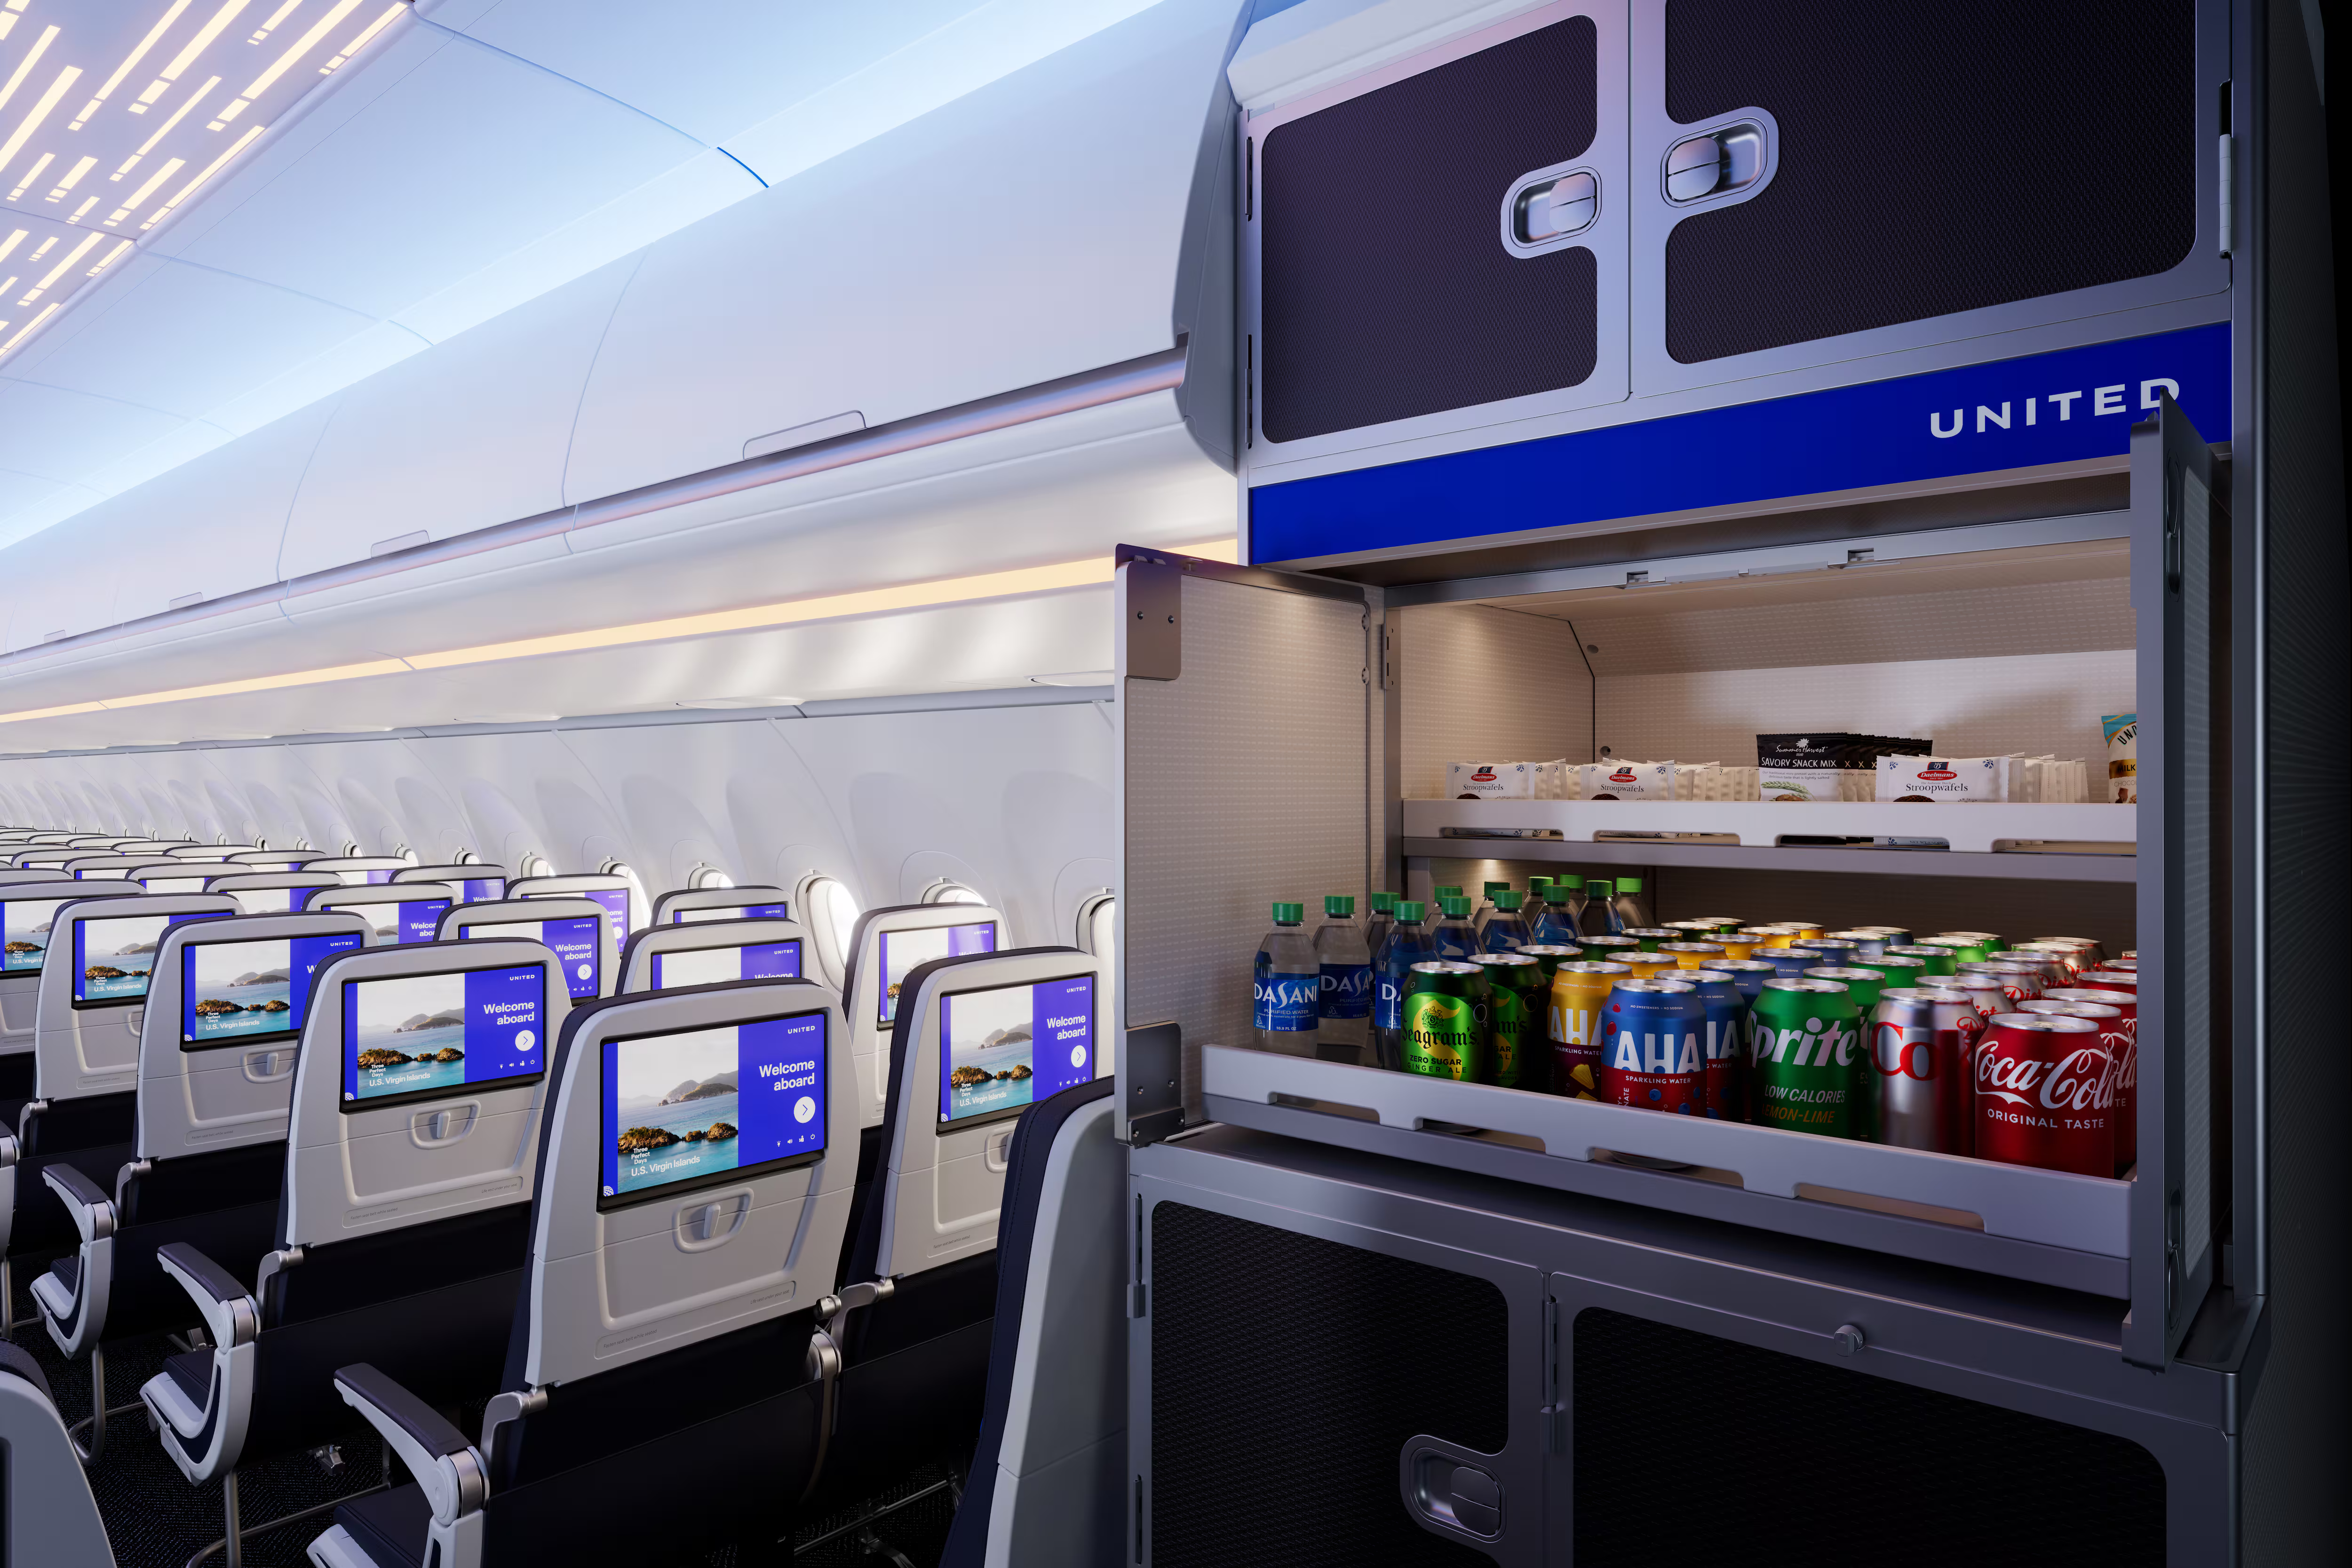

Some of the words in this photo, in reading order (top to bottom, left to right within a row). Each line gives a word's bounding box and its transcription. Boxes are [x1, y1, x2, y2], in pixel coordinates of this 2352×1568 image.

[1931, 378, 2179, 438] UNITED
[1762, 757, 1790, 766] SAVORY
[1463, 784, 1503, 792] Stroopwafels
[1601, 784, 1644, 793] Stroopwafels
[1906, 783, 1968, 794] Stroopwafels
[565, 951, 591, 960] aboard
[1320, 971, 1370, 997] DASA
[1254, 982, 1317, 1008] DASANI
[484, 1002, 534, 1014] Welcome
[497, 1011, 534, 1025] aboard
[1047, 1015, 1086, 1028] Welcome
[788, 1026, 815, 1034] UNITED
[1057, 1025, 1086, 1040] aboard
[1751, 1010, 1857, 1068] Sprite
[1555, 1046, 1581, 1055] SPARKLING
[1614, 1031, 1701, 1074] AHA
[1410, 1055, 1429, 1064] ZERO
[759, 1060, 815, 1077] Welcome
[1407, 1062, 1441, 1073] GINGER
[407, 1073, 430, 1081] Islands
[774, 1073, 815, 1091] aboard
[1625, 1075, 1667, 1084] SPARKLING
[1976, 1041, 2114, 1110] Coca-Cola
[972, 1095, 987, 1104] Virgin
[989, 1091, 1007, 1100] Islands
[1765, 1084, 1788, 1100] LOW
[1789, 1089, 1845, 1103] CALORIES
[1762, 1104, 1835, 1123] LEMON-LIME
[1987, 1108, 2058, 1128] ORIGINAL
[2065, 1119, 2104, 1129] TASTE
[631, 1166, 648, 1176] U.S.
[650, 1162, 672, 1172] Virgin
[674, 1156, 700, 1168] Islands
